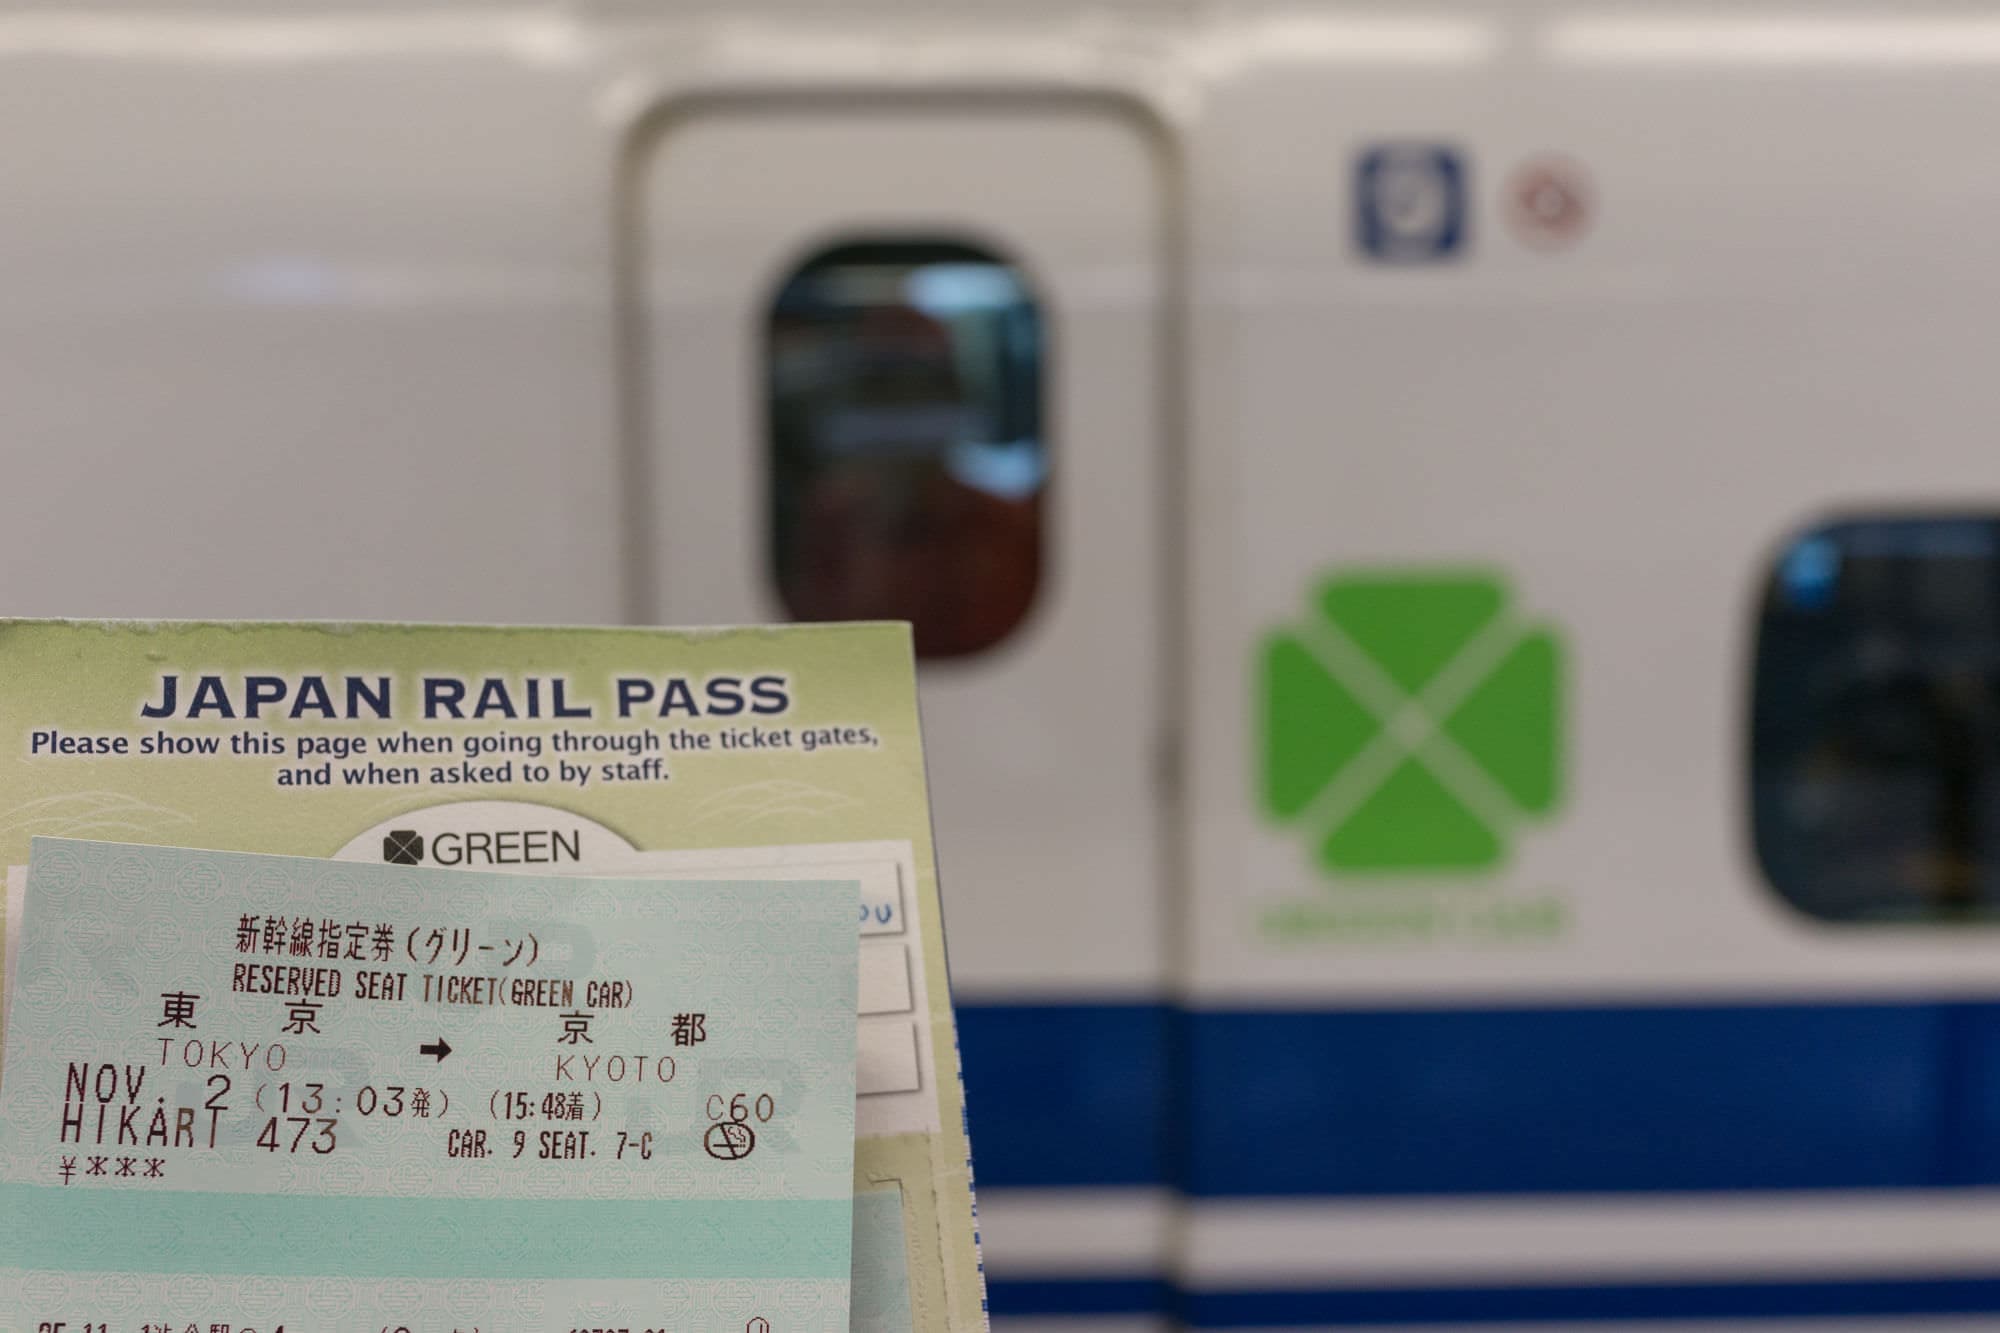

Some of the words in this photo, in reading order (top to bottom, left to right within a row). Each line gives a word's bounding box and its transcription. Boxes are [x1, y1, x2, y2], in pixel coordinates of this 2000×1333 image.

[140, 676, 391, 719] JAPAN
[423, 677, 592, 718] RAIL
[616, 676, 790, 718] PASS
[31, 732, 129, 755] Please
[139, 734, 220, 755] show
[230, 732, 286, 755] this
[298, 738, 367, 759] page
[377, 731, 453, 755] when
[463, 731, 542, 757] going
[552, 729, 660, 755] through
[669, 730, 711, 750] the
[720, 728, 792, 749] ticket
[801, 726, 879, 750] gates,
[277, 762, 332, 786] and
[343, 762, 420, 785] when
[429, 761, 512, 784] asked
[522, 765, 550, 783] to
[559, 760, 592, 787] by
[601, 758, 670, 782] staff.
[432, 829, 581, 866] GREEN
[232, 962, 342, 998] RESERVED
[354, 970, 408, 1001] SEAT
[585, 979, 634, 1009] CAR)
[157, 1036, 287, 1072] TOKYO
[555, 1054, 678, 1083] KYOTO
[65, 1062, 166, 1105] NOV.
[204, 1073, 232, 1110] 2
[706, 1092, 775, 1123] C60
[256, 1116, 338, 1155] 473
[447, 1128, 494, 1159] CAR.
[512, 1129, 527, 1160] 9
[538, 1130, 597, 1160] SEAT.
[616, 1130, 654, 1161] 7-C
